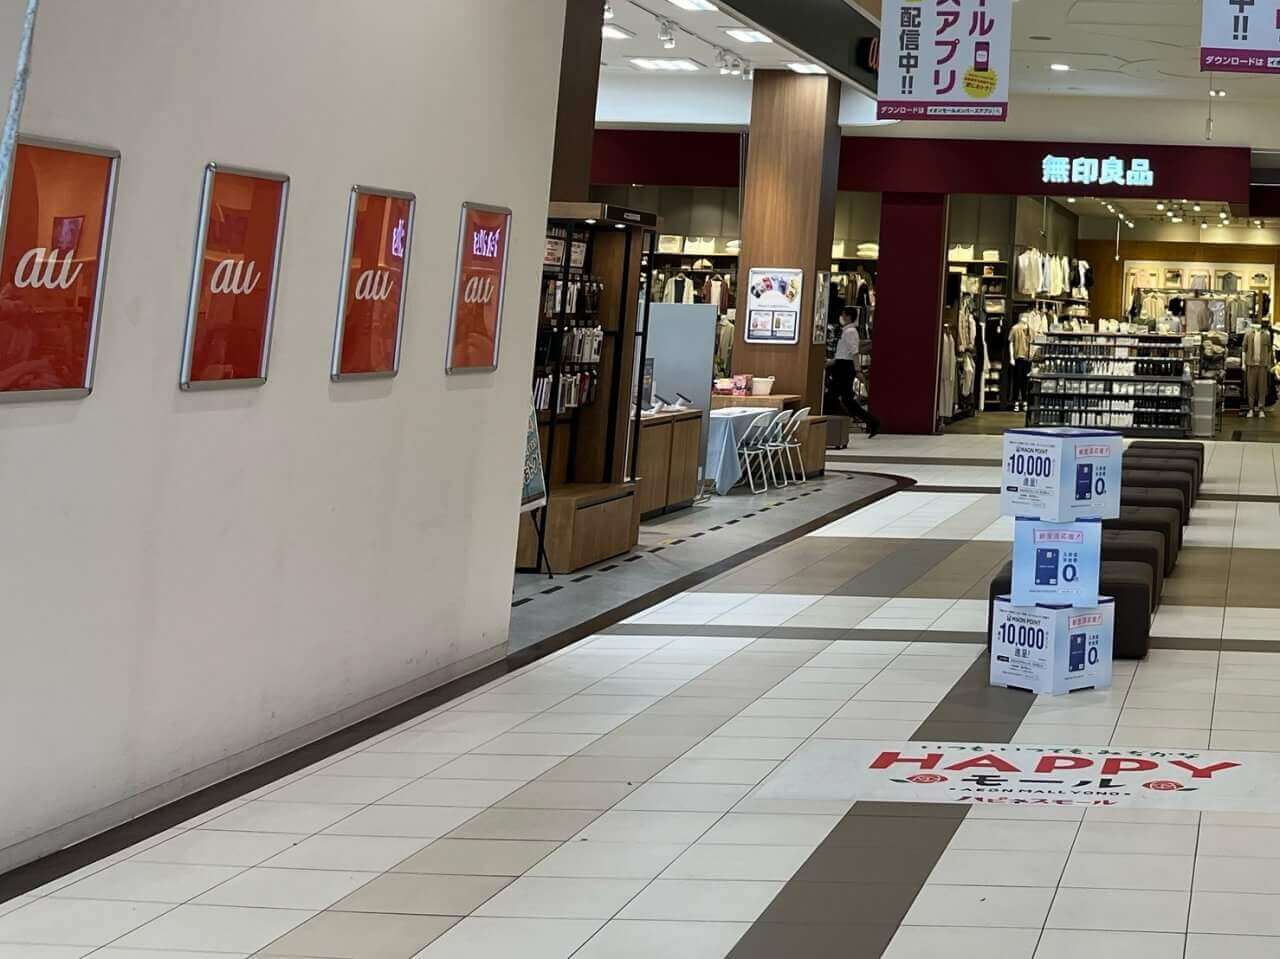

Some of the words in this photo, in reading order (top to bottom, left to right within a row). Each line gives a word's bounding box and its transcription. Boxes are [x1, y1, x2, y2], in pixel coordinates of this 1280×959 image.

[898, 6, 922, 95] 配信中!!
[1205, 55, 1264, 66] ダウンロードは
[880, 105, 924, 115] ダウンロードは
[1042, 154, 1153, 186] 無印良品
[14, 246, 83, 289] au
[210, 258, 260, 295] au
[355, 268, 394, 301] au
[464, 271, 494, 303] au
[1009, 453, 1051, 477] 10,000
[999, 622, 1045, 650] 10,000
[868, 751, 1243, 778] HAPPY
[961, 774, 1126, 789] モール
